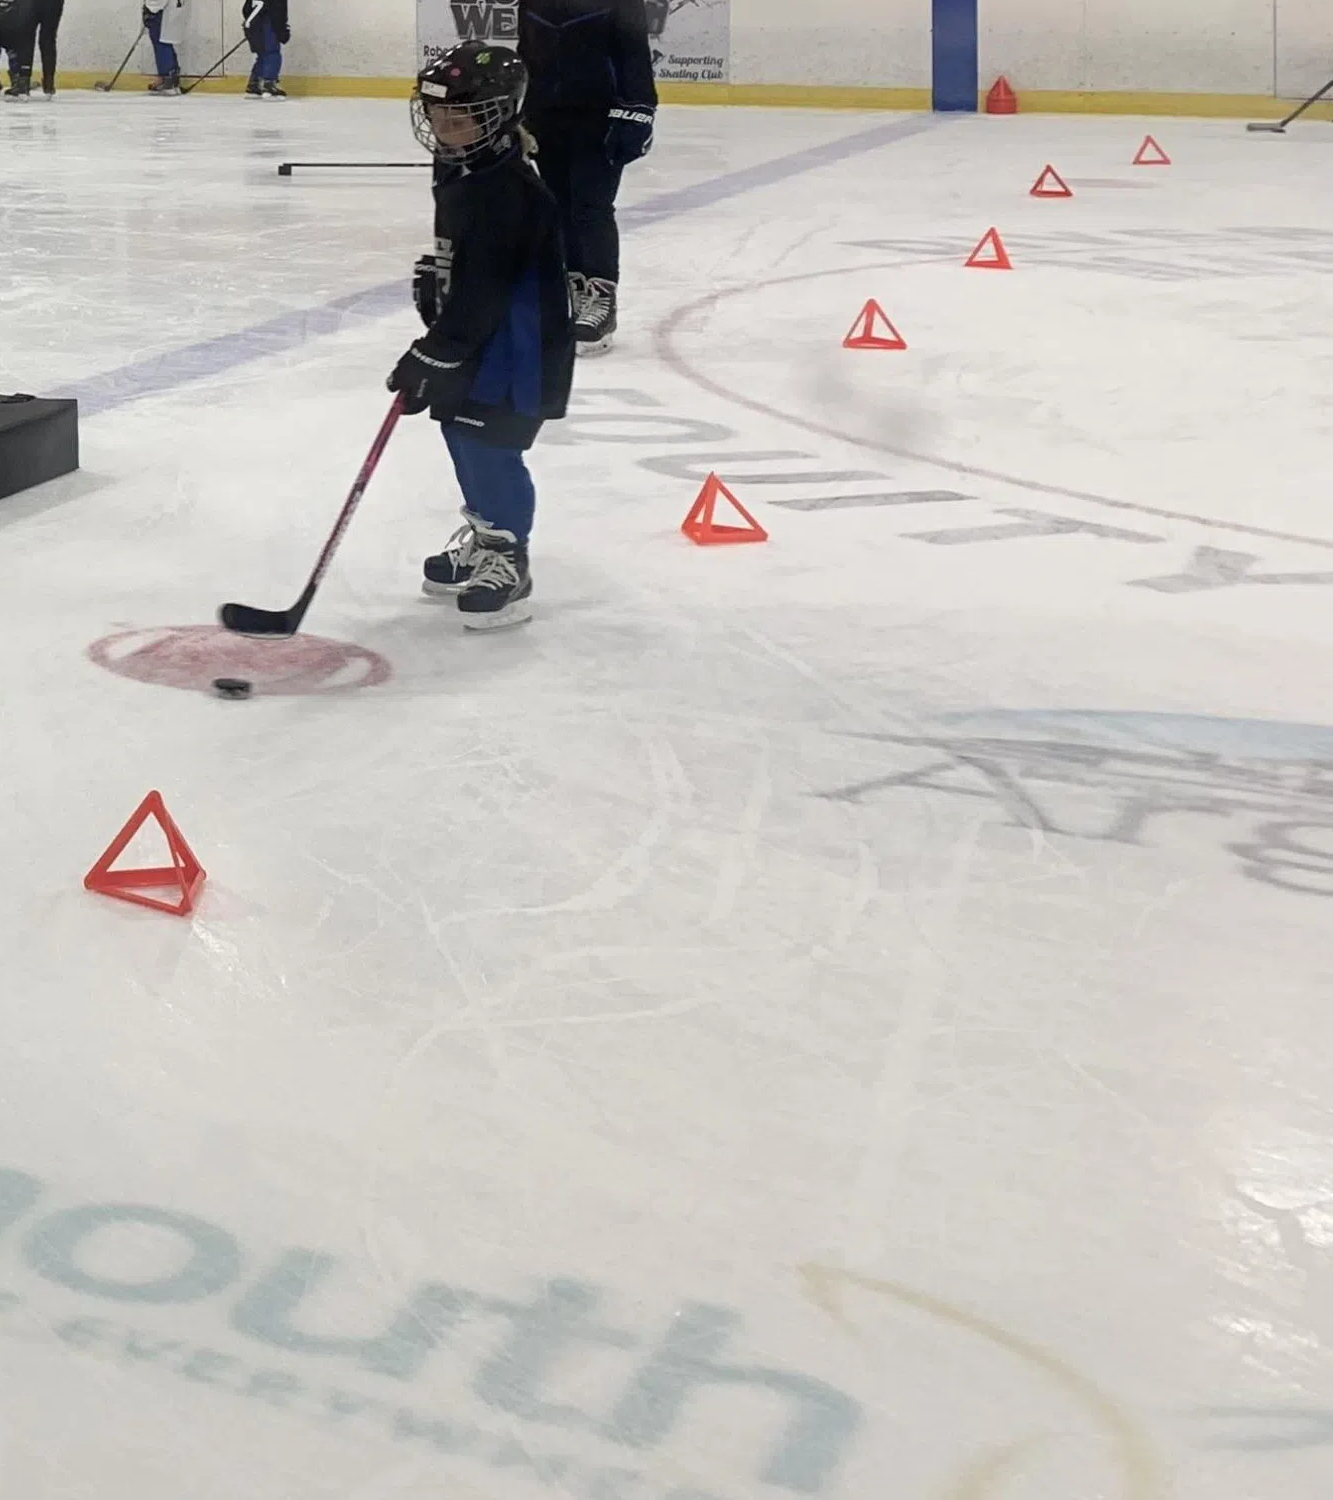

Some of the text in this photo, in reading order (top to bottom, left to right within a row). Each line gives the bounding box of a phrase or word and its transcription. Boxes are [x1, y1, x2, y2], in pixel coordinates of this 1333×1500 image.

[668, 55, 723, 68] Supporting
[659, 70, 723, 81] Skating Club
